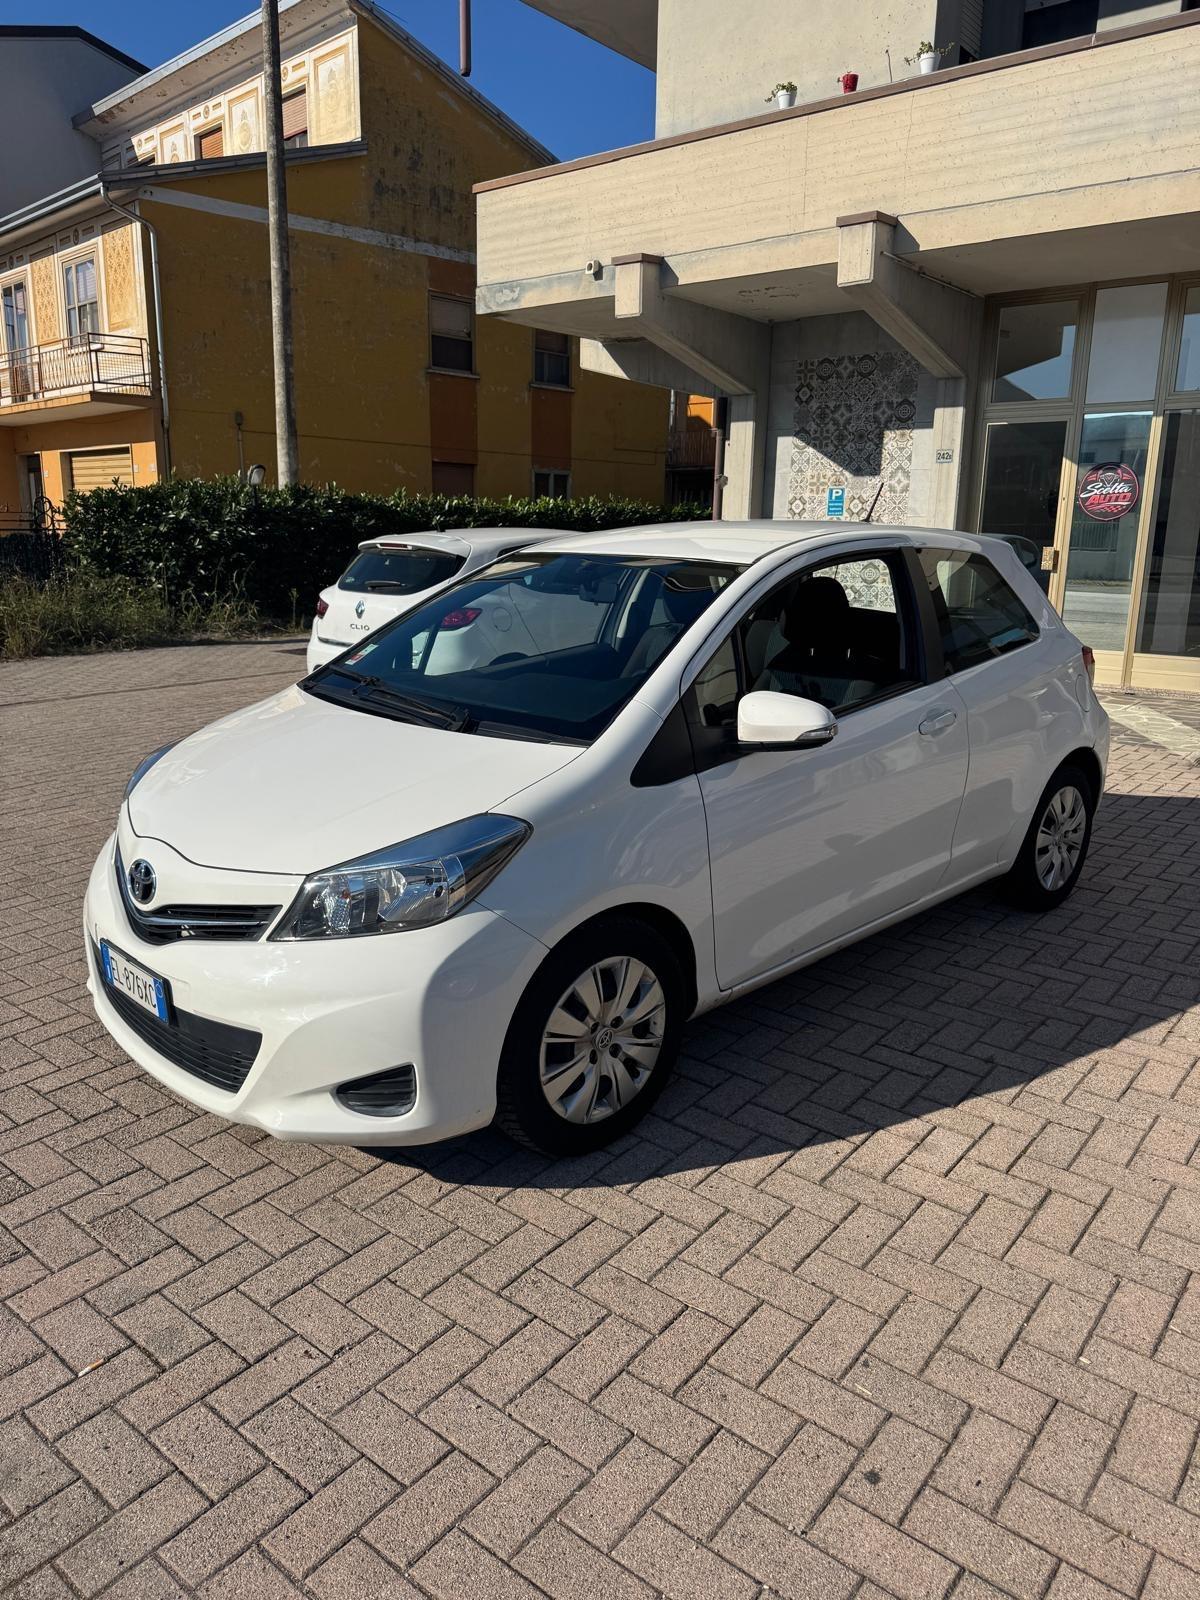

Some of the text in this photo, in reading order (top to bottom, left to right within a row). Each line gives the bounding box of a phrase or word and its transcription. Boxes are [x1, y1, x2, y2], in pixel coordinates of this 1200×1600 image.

[832, 489, 843, 500] P
[1080, 483, 1132, 498] Scelta
[1085, 493, 1132, 505] AUTO
[350, 623, 370, 631] CLIO
